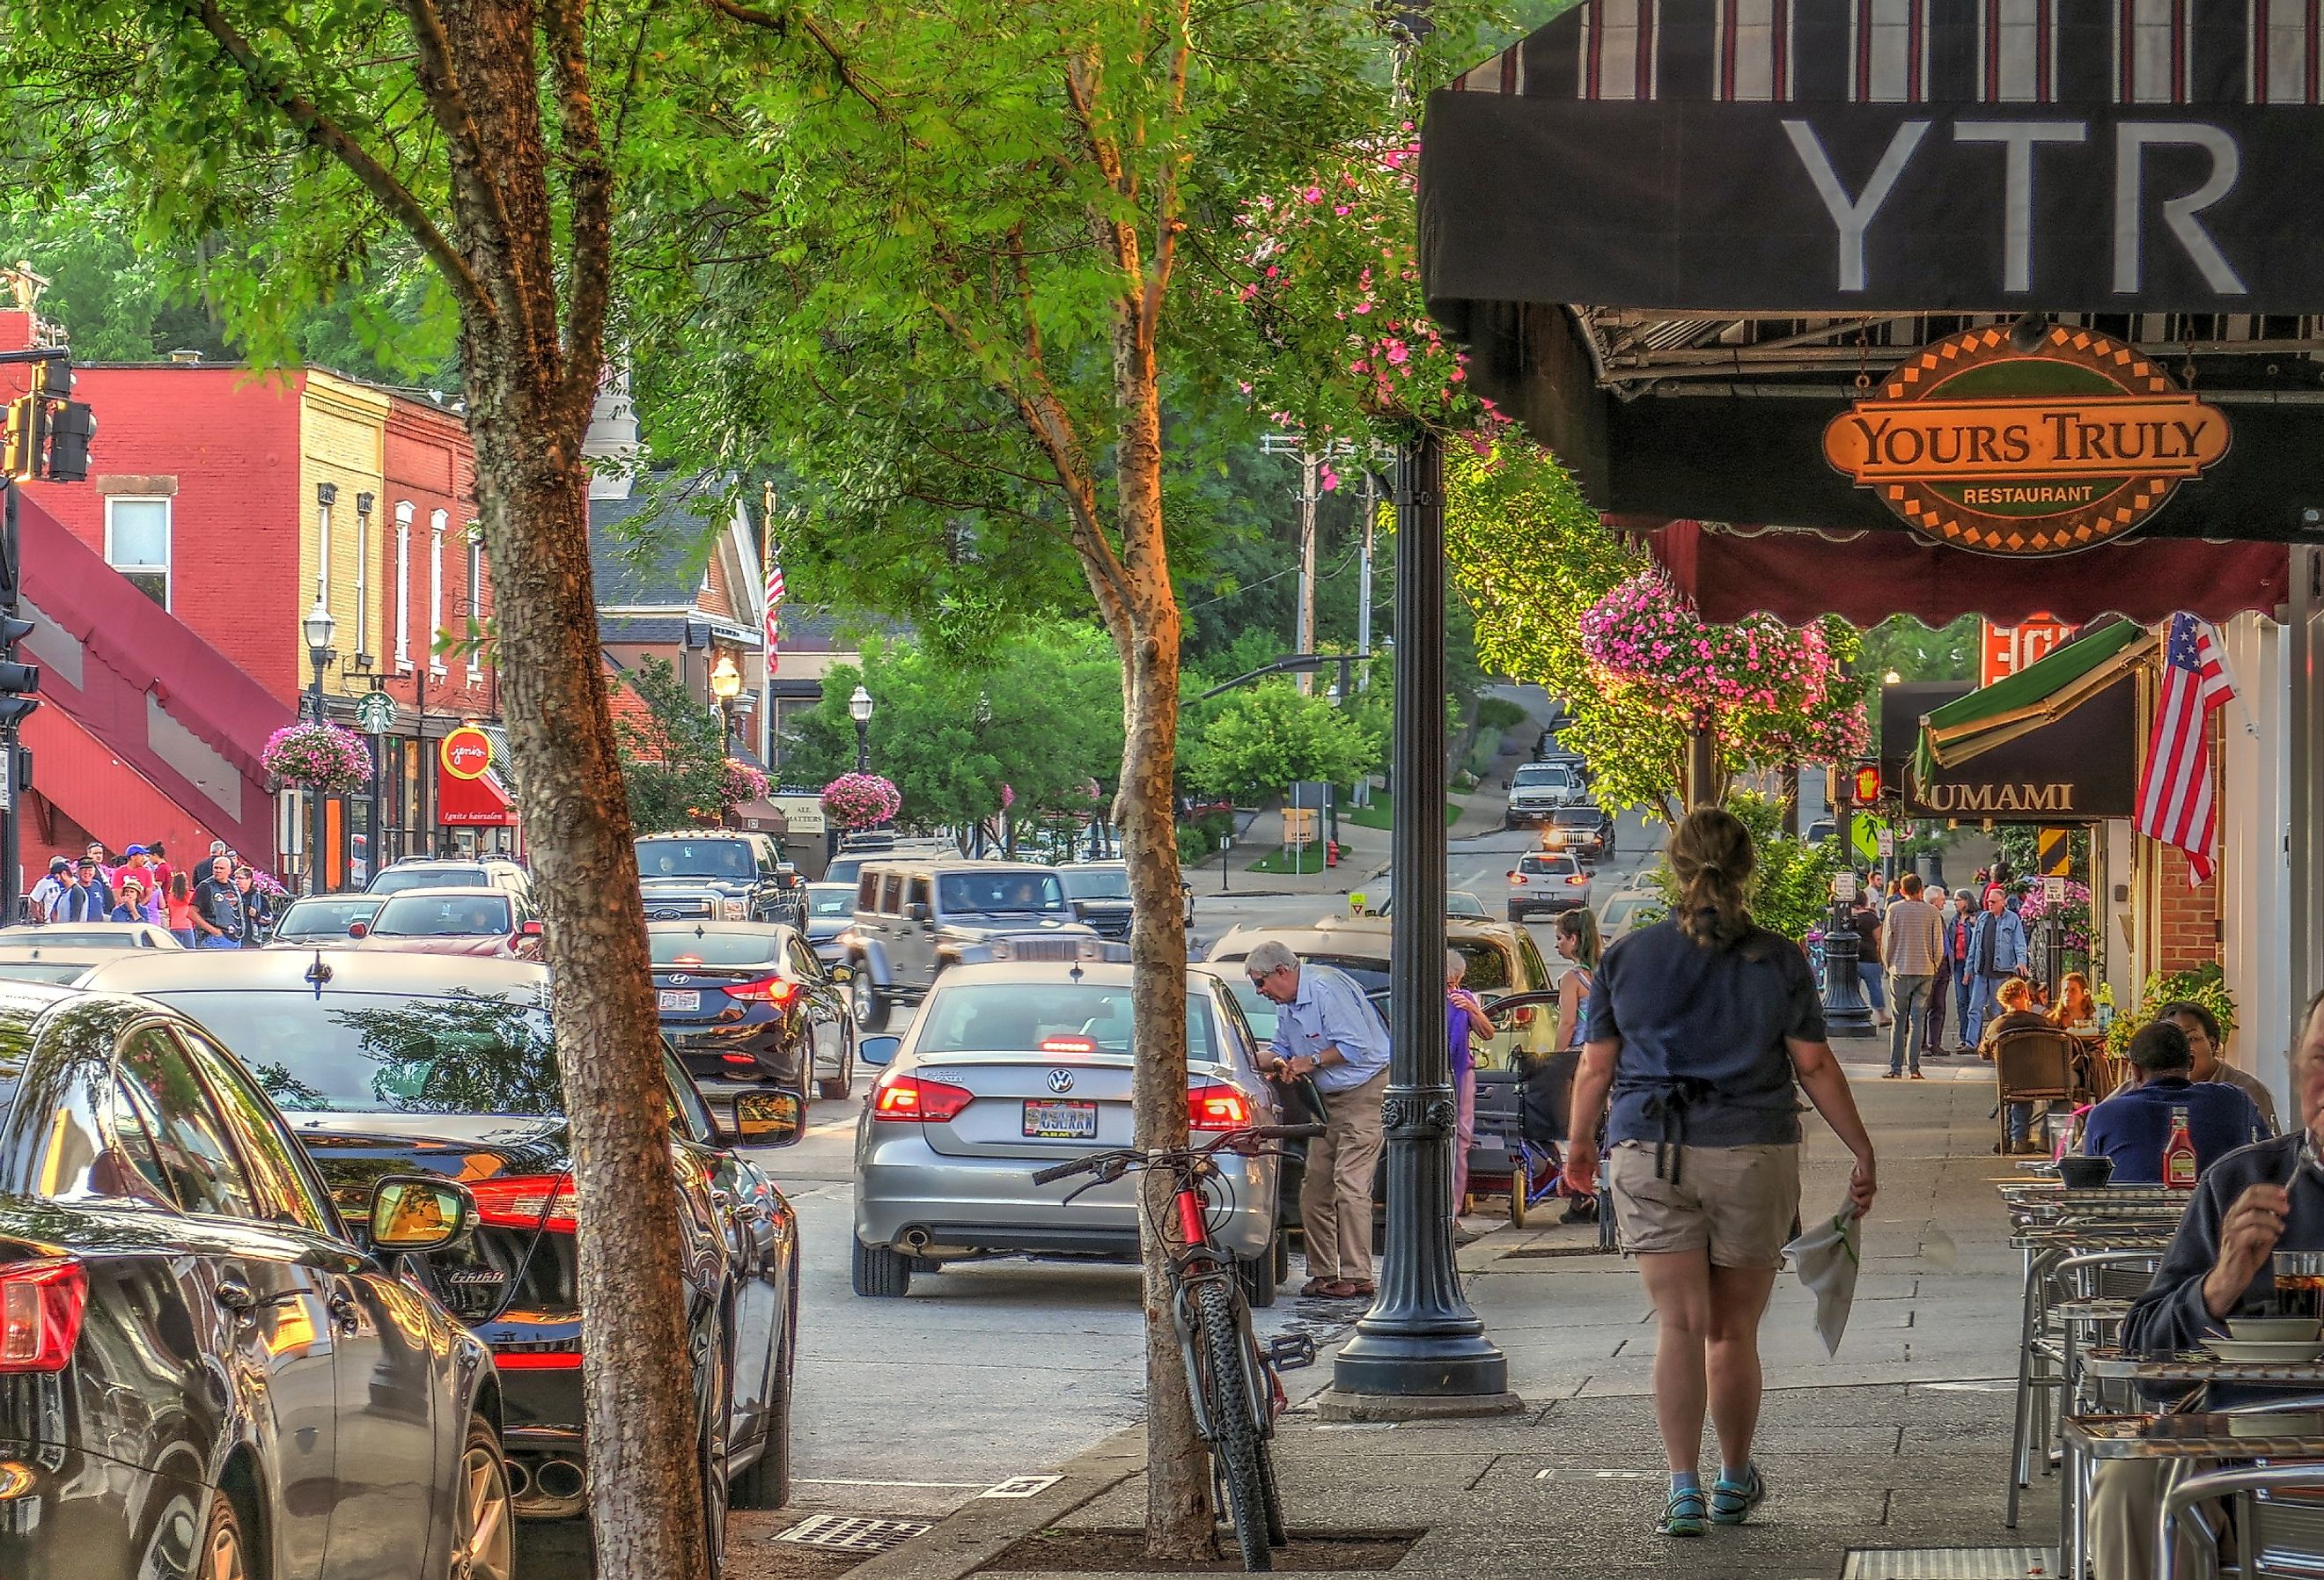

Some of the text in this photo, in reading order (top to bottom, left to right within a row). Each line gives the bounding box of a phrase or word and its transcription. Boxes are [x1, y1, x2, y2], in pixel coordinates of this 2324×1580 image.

[1781, 120, 2247, 295] YTR
[1851, 412, 2207, 466] YOURS TRULY
[1963, 485, 2093, 505] RESTAURANT
[1931, 783, 2074, 812] UMAMI
[445, 811, 503, 822] Ignite hairsalon
